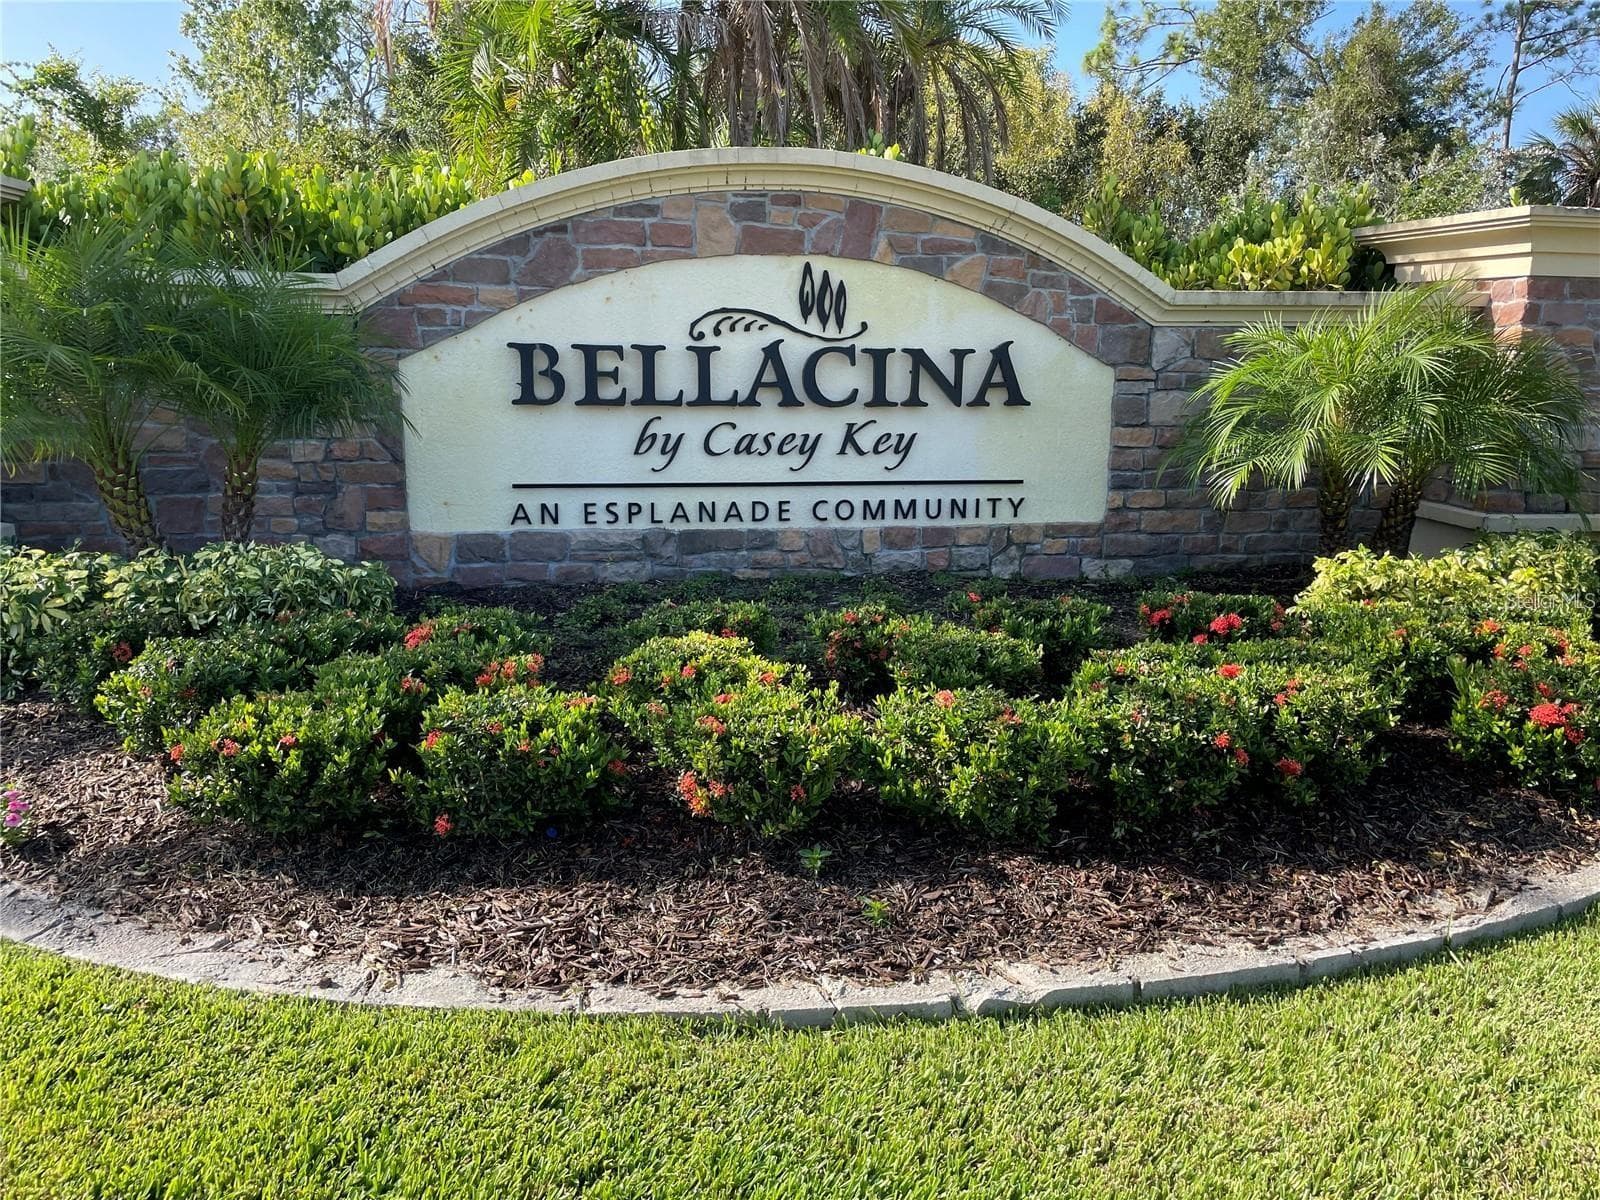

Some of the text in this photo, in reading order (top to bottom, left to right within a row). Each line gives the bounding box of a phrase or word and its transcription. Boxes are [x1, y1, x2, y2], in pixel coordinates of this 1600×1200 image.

[507, 339, 1031, 407] BELLACINA
[634, 416, 917, 472] by Casey Key
[511, 498, 1025, 525] AN ESPLANADE COMMUNITY
